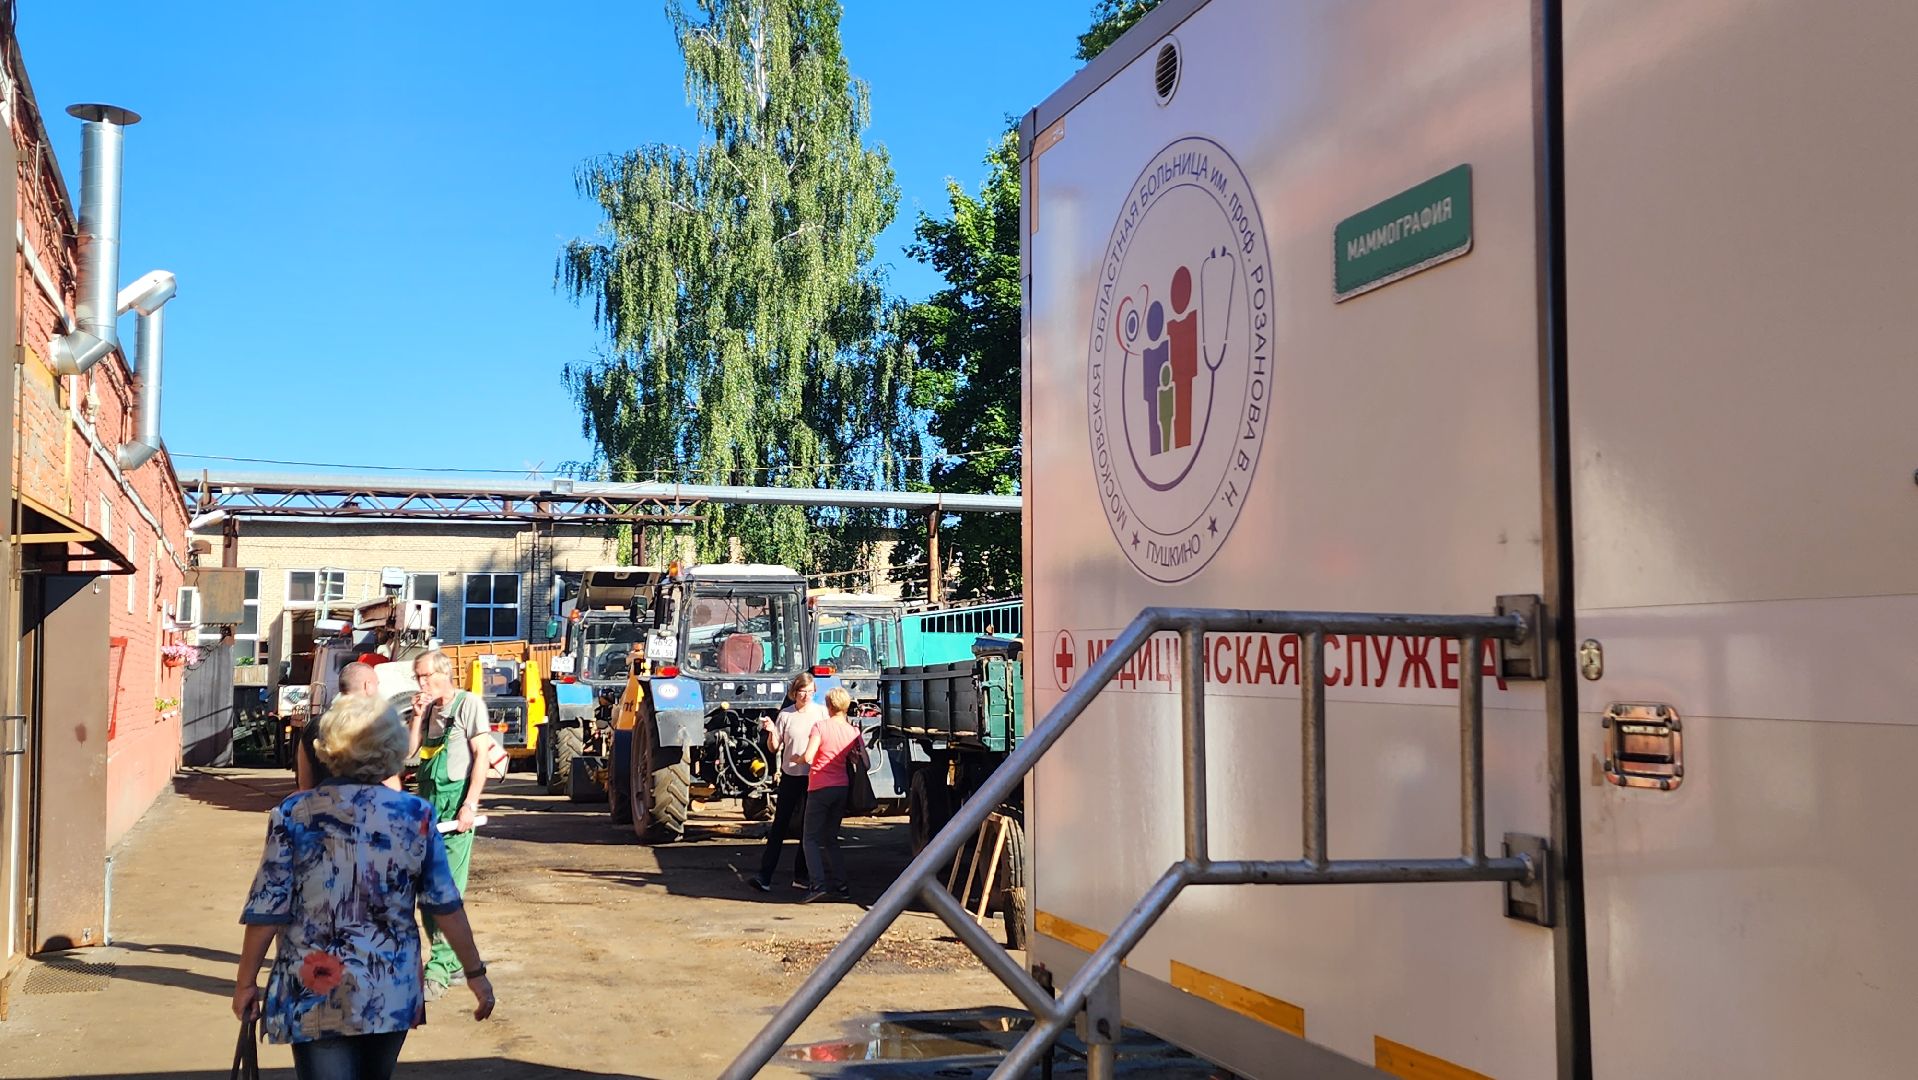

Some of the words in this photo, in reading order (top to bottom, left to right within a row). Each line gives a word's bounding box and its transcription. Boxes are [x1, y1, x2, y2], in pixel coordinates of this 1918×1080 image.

[1140, 152, 1208, 207] БОЛЬНИЦА
[1347, 196, 1453, 261] МАММОГРАФИЯ
[1094, 200, 1139, 352] ОБЛАСТНАЯ
[1243, 264, 1267, 440] РОЗАНОВА
[1092, 363, 1127, 530] МОСКОВСКАЯ
[1234, 449, 1250, 472] В.
[1221, 481, 1239, 507] Н.
[1146, 534, 1201, 567] ПУШКИНО
[1087, 634, 1300, 692] МДИЦСКАЯ
